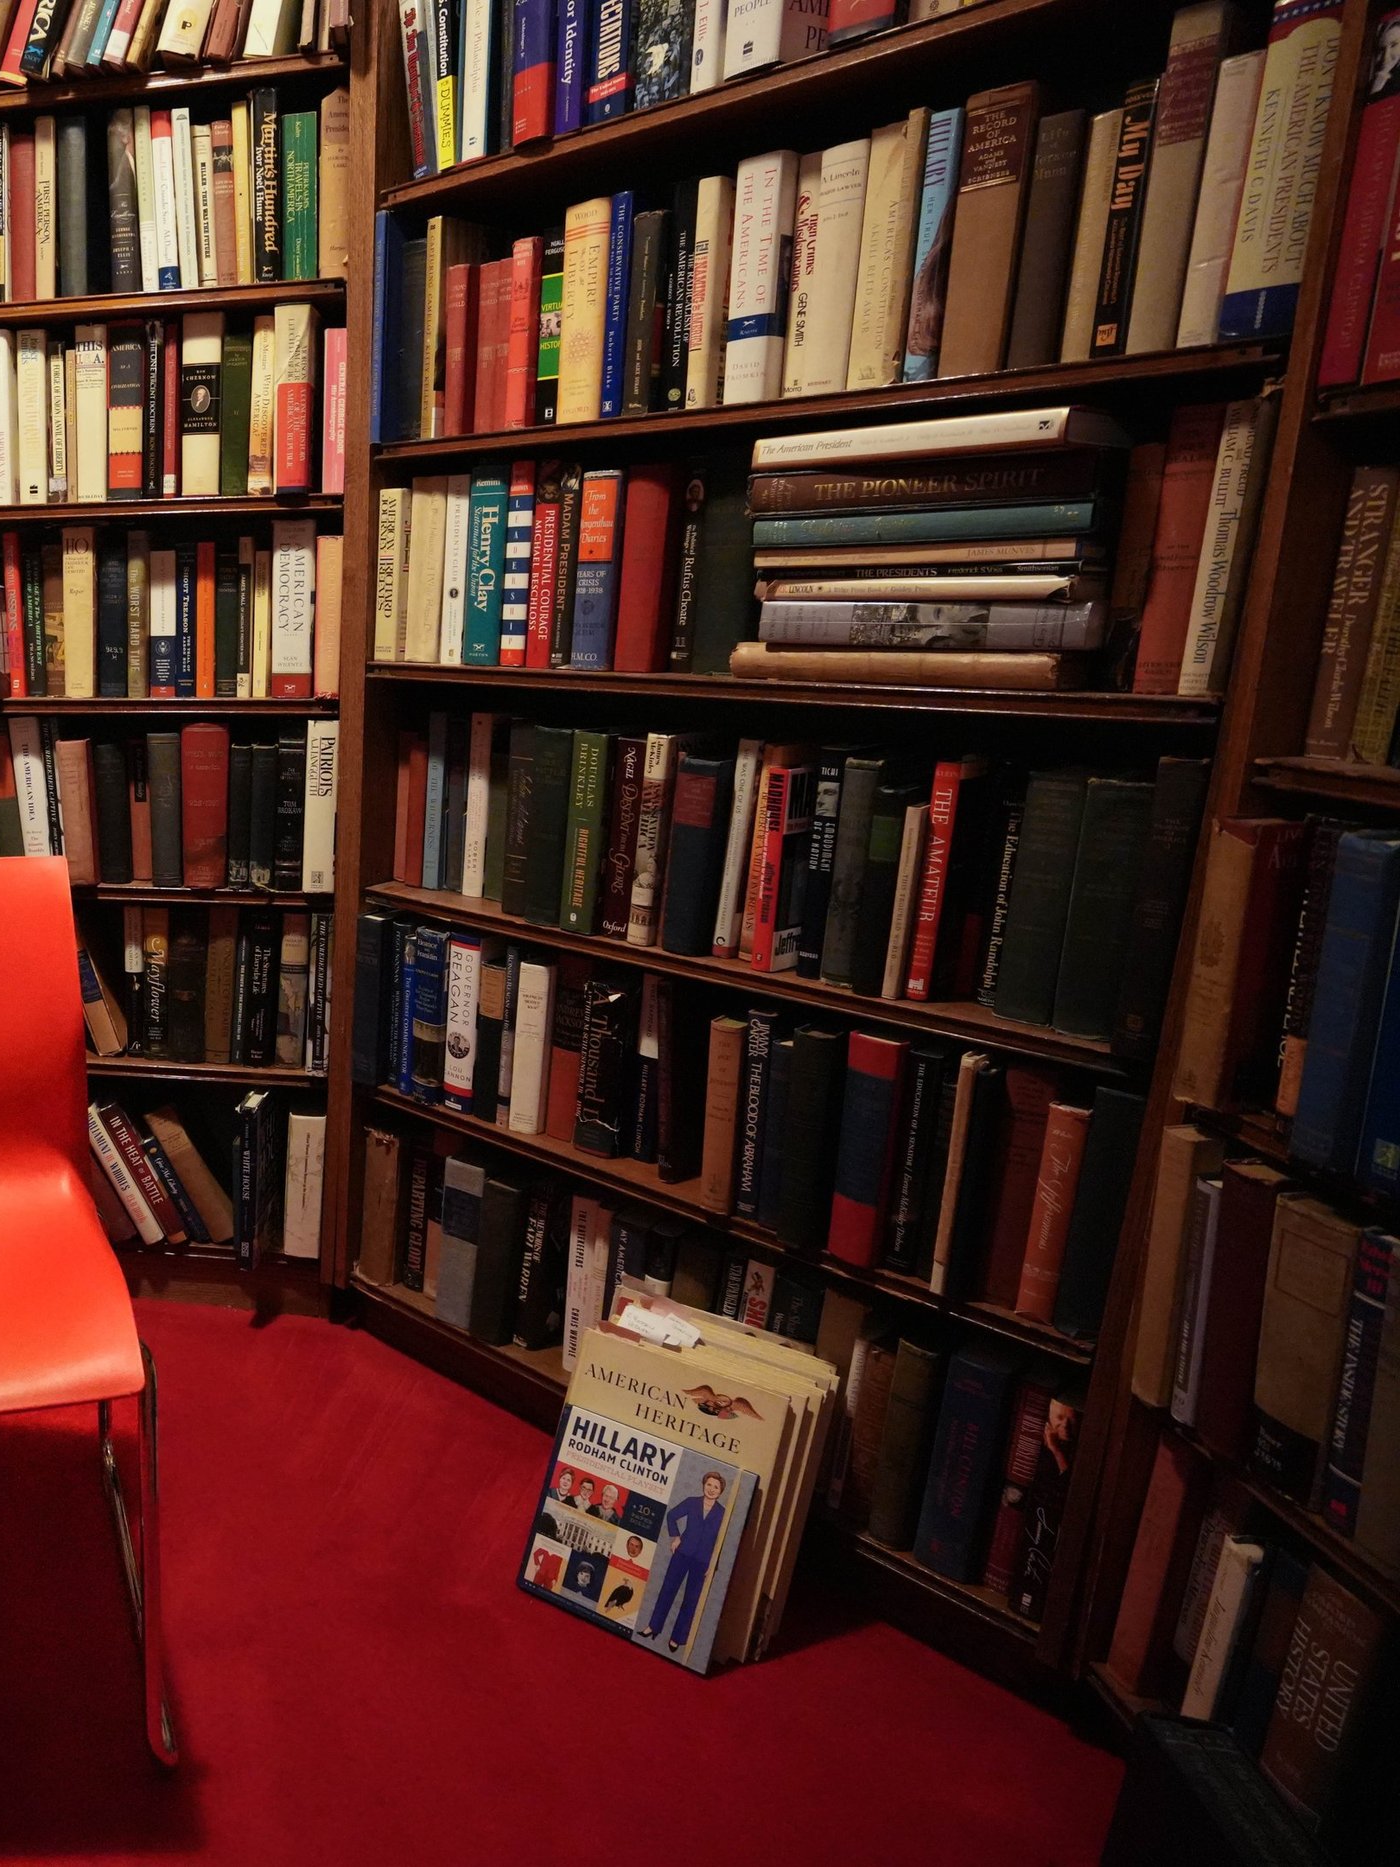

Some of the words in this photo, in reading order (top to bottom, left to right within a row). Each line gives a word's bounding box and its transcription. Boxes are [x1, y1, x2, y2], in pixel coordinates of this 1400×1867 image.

[734, 0, 771, 18] PEOPLE
[436, 9, 448, 77] Constitution
[559, 25, 578, 86] Identity
[440, 88, 452, 149] DUMMIES
[972, 116, 1017, 134] RECORD
[984, 111, 1006, 122] THE
[987, 129, 1001, 139] OF
[1118, 116, 1148, 158] My
[1253, 89, 1281, 172] KENNETH
[263, 111, 277, 178] Martin's
[923, 117, 952, 188] HILLARY
[967, 134, 1017, 152] AMERICA
[286, 181, 295, 223] AMERICA
[743, 173, 754, 206] THE
[762, 194, 775, 226] THE
[1110, 162, 1144, 210] Day
[264, 181, 280, 253] Hundred
[1240, 195, 1260, 244] DAVIS
[1262, 173, 1294, 275] PRESIDENTS
[616, 224, 624, 293] CONSERVATIVE
[676, 252, 685, 300] AMERICAN
[735, 213, 753, 310] AMERICANS
[759, 233, 772, 276] TIME
[612, 295, 620, 322] PARTY
[684, 271, 694, 330] RADICALISM
[754, 283, 766, 305] OF
[111, 344, 142, 352] AMERICA
[672, 304, 683, 368] REVOLUTION
[777, 441, 814, 454] American
[816, 438, 853, 452] President
[586, 490, 606, 503] From
[814, 482, 858, 500] THE
[861, 475, 958, 498] PIONEER
[964, 468, 1047, 492] SPIRIT
[561, 493, 574, 540] MADAM
[588, 504, 599, 515] the
[1213, 508, 1241, 557] Thomas
[480, 504, 499, 568] Henry
[532, 520, 542, 571] MICHAEL
[542, 510, 555, 580] PRESIDENTIAL
[581, 532, 607, 544] Diaries
[1347, 482, 1389, 605] STRANGER
[279, 542, 290, 632] DEMOCRACY
[292, 543, 305, 632] AMERICAN
[474, 569, 495, 613] Clay
[556, 543, 570, 611] PRESIDENT
[578, 578, 600, 586] CRISIS
[684, 556, 695, 590] Rufus
[873, 568, 937, 578] PRESIDENTS
[1017, 564, 1060, 572] Smithsonian
[1203, 560, 1229, 619] Woodrow
[130, 580, 139, 618] WORST
[528, 573, 540, 631] BESCHLOSS
[538, 583, 550, 640] COURAGE
[678, 592, 692, 626] Choate
[131, 621, 139, 646] HARD
[1192, 621, 1217, 664] Wilson
[130, 650, 140, 672] TIME
[318, 736, 336, 797] PATRIOTS
[576, 743, 589, 808] BRINKLEY
[587, 748, 599, 808] DOUGLAS
[626, 747, 636, 779] NAGEL
[821, 766, 839, 776] TICHI
[767, 772, 784, 832] MADHOUSE
[933, 789, 952, 824] THE
[578, 827, 589, 871] RIGHTFUL
[999, 824, 1019, 891] Education
[572, 872, 586, 909] HERITAGE
[919, 834, 945, 922] AMATEUR
[603, 921, 626, 933] Oxford
[993, 905, 1008, 932] John
[150, 937, 165, 1023] Mayflower
[982, 935, 1003, 988] Randolph
[450, 950, 464, 1024] REAGAN
[462, 954, 474, 1027] GOVERNOR
[584, 1015, 612, 1103] Thousand
[748, 1018, 760, 1056] CARTER
[634, 1124, 643, 1153] CLINTON
[116, 1127, 127, 1144] THE
[126, 1144, 143, 1167] HEAT
[141, 1175, 163, 1205] BATTLE
[241, 1150, 250, 1177] WHITE
[740, 1141, 756, 1192] ABRAHAM
[242, 1177, 250, 1201] HOUSE
[519, 1249, 533, 1303] WARREN
[585, 1363, 688, 1410] AMERICAN
[572, 1416, 675, 1471] HILLARY
[635, 1403, 741, 1454] HERITAGE
[568, 1440, 617, 1465] RODHAM
[619, 1459, 668, 1485] CLINTON
[1293, 1648, 1329, 1731] STATES
[1315, 1660, 1359, 1753] UNITED
